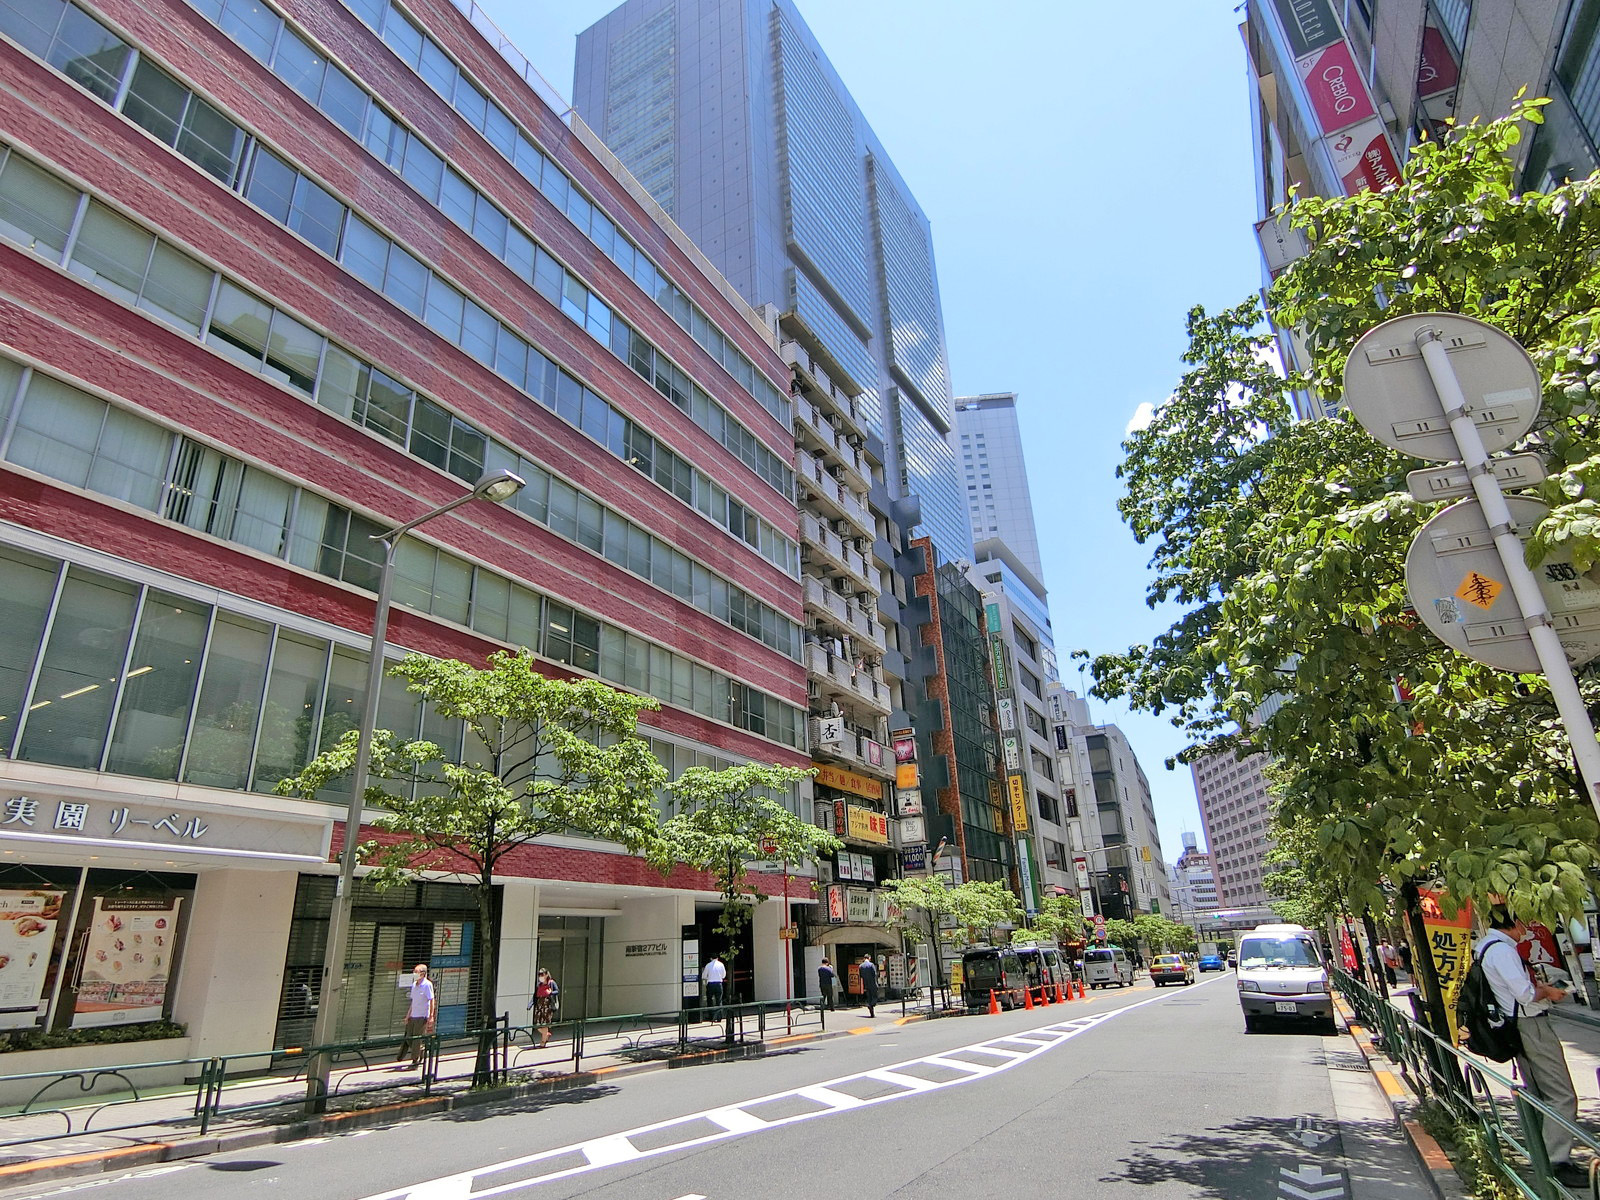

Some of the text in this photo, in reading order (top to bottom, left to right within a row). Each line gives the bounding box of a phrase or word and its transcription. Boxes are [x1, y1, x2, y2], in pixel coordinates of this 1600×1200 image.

[1322, 65, 1357, 115] CREBIQ
[1012, 779, 1022, 818] 切手センター
[869, 815, 887, 836] 味屋
[1021, 857, 1030, 890] FamilyMart
